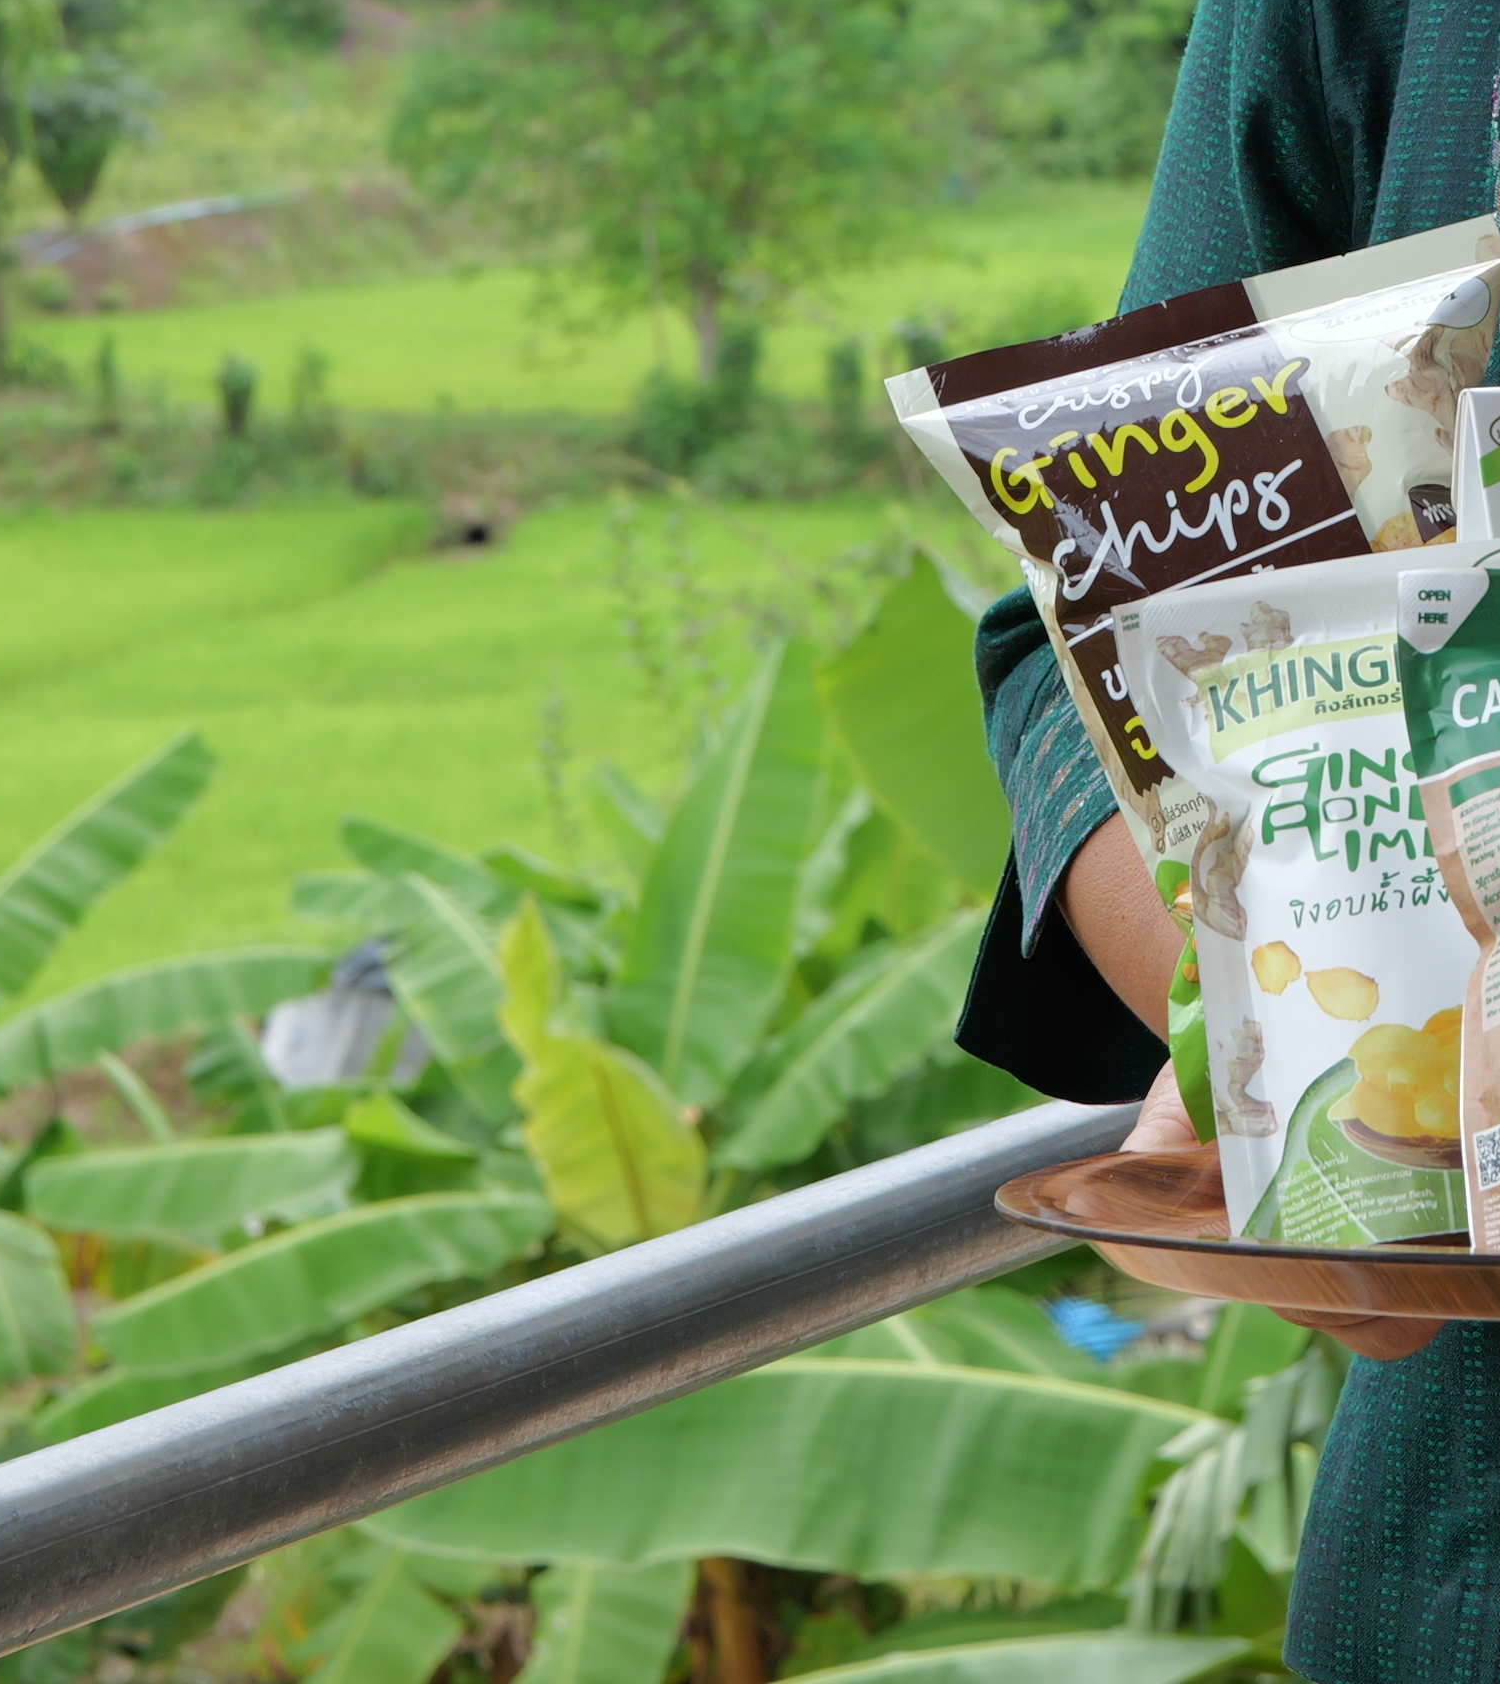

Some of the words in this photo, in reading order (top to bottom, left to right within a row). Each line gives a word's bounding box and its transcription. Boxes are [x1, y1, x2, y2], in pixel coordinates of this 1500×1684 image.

[990, 361, 1302, 515] Ginger
[1418, 590, 1451, 602] OPEN
[1418, 612, 1449, 624] HERE
[1208, 643, 1400, 733] KHING
[1251, 742, 1416, 792] GIN
